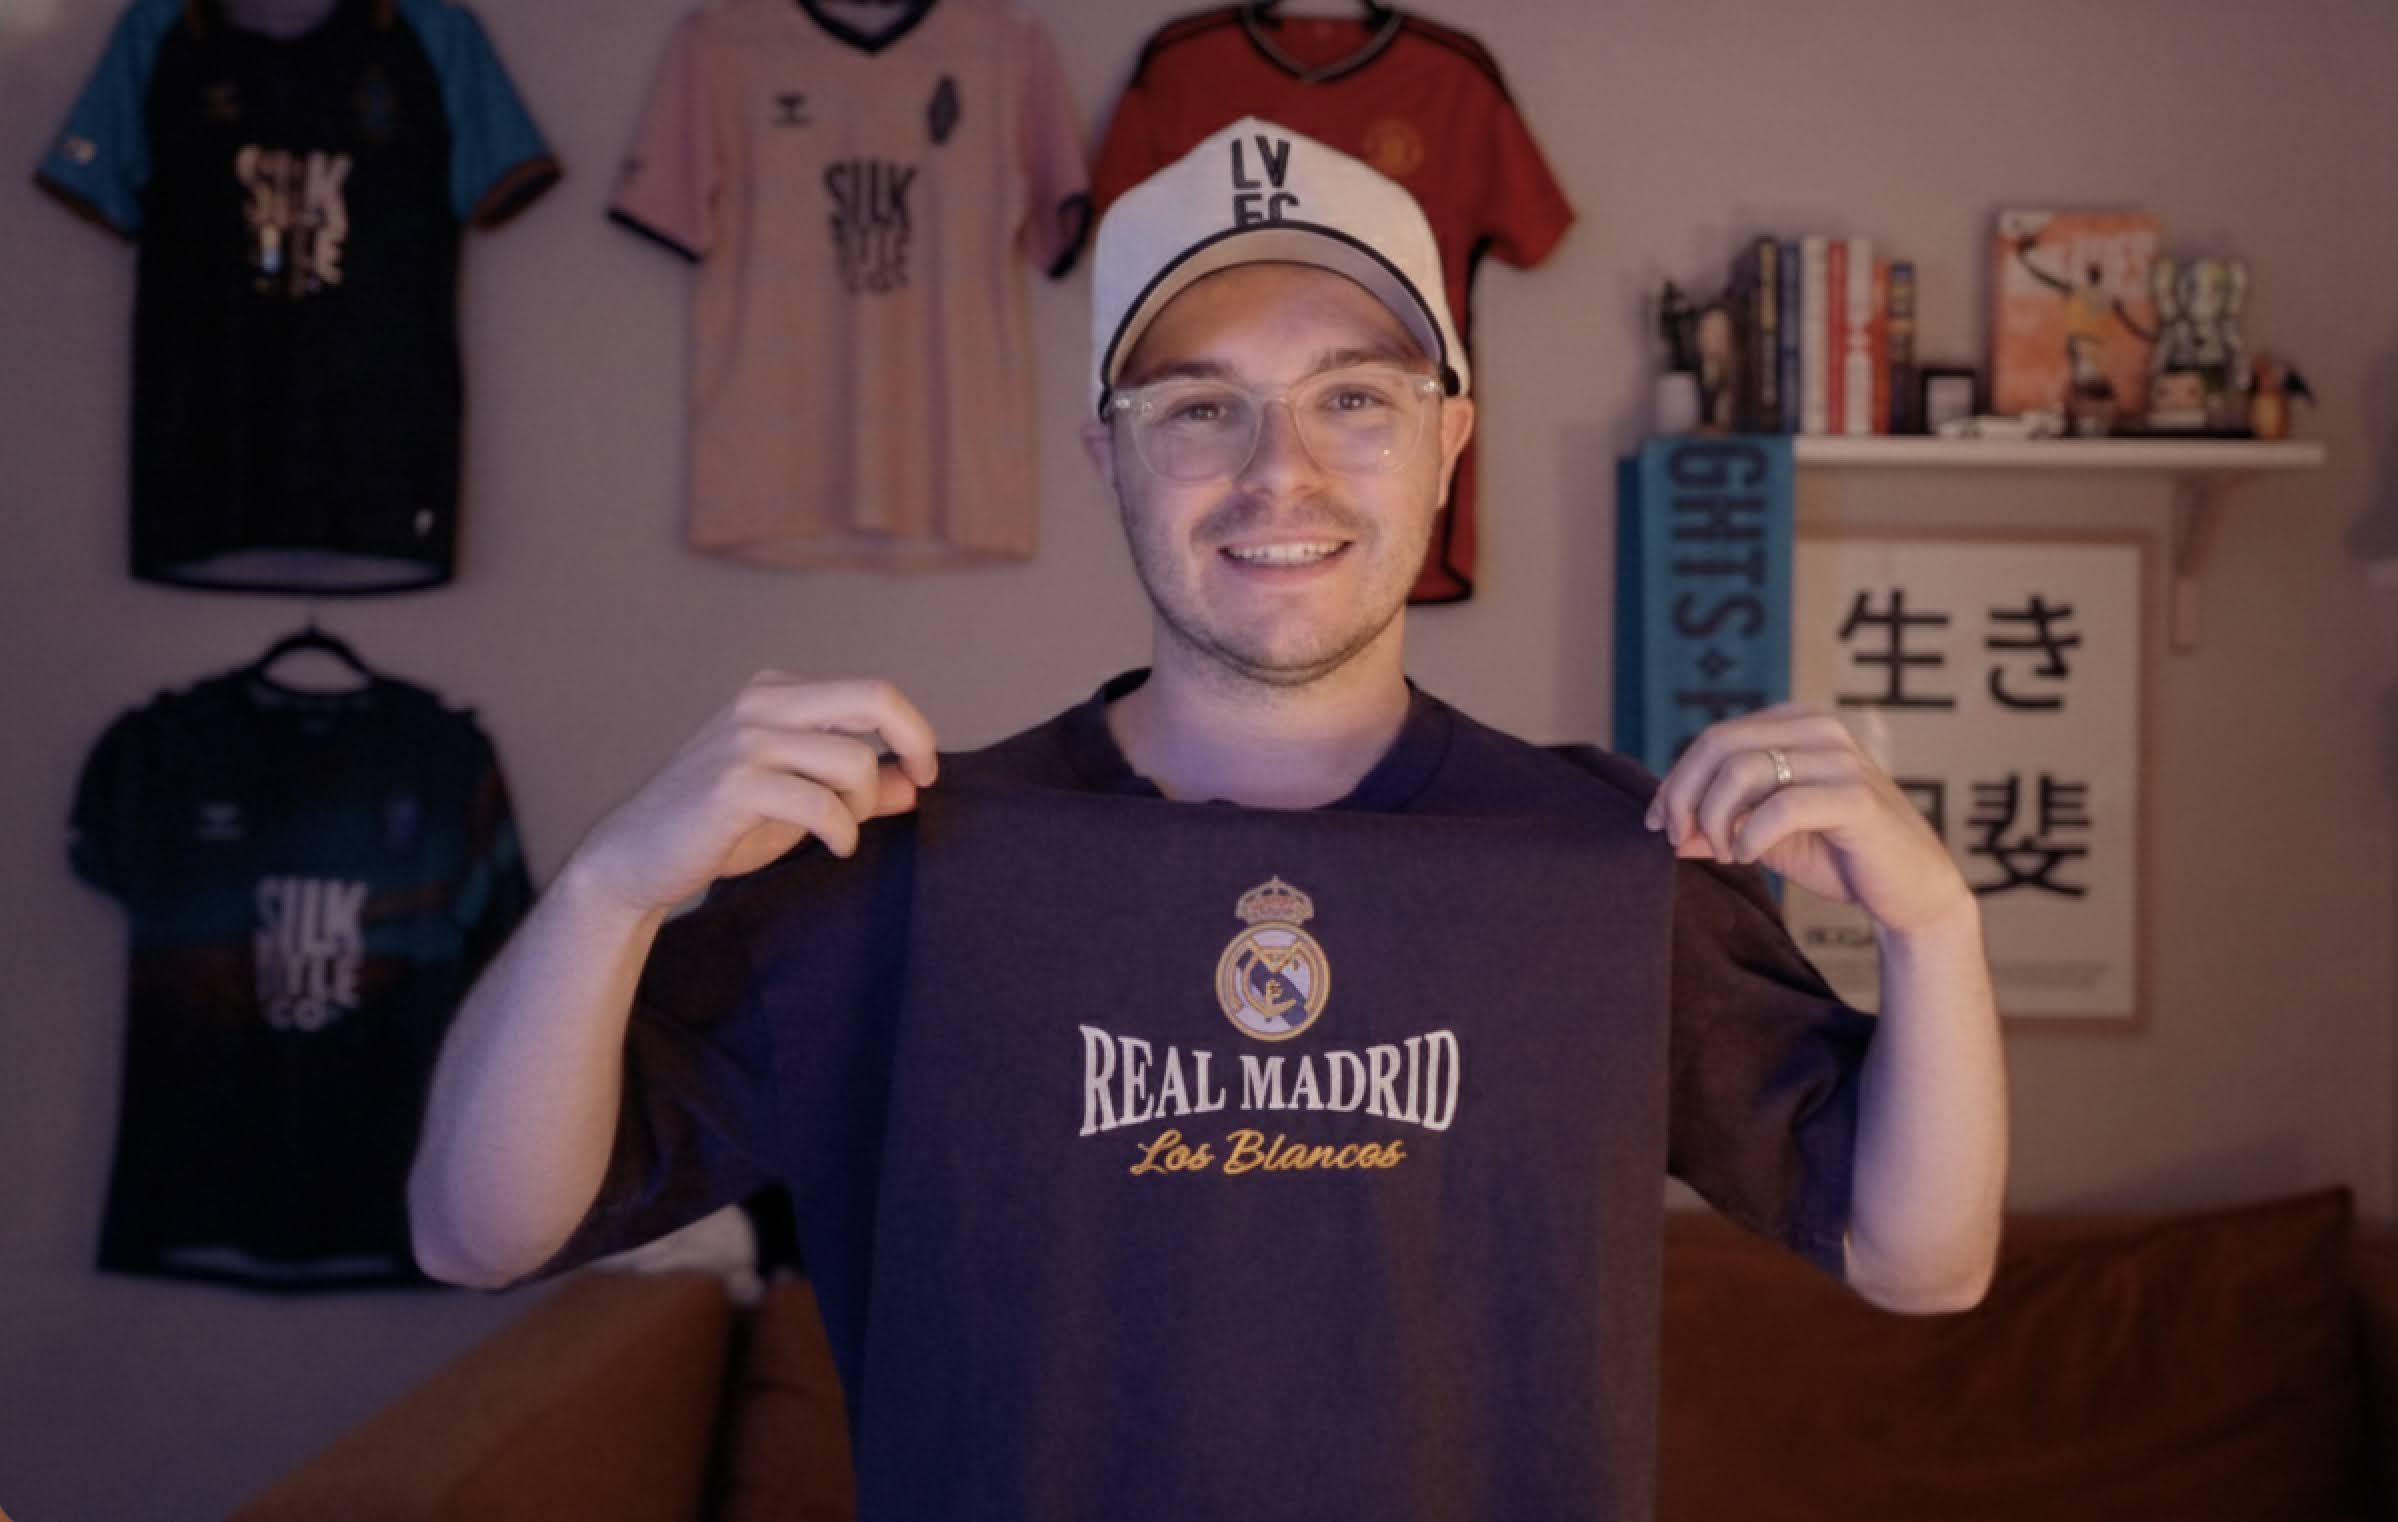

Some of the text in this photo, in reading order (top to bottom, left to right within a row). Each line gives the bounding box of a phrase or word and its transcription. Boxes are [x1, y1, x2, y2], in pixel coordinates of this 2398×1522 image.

[823, 158, 917, 229] SILK
[1231, 135, 1291, 189] LV
[1837, 589, 2080, 712] 生き
[254, 875, 368, 952] SILK
[1079, 1024, 1460, 1136] REAL MADRID
[1129, 1128, 1408, 1176] Los Blancos
